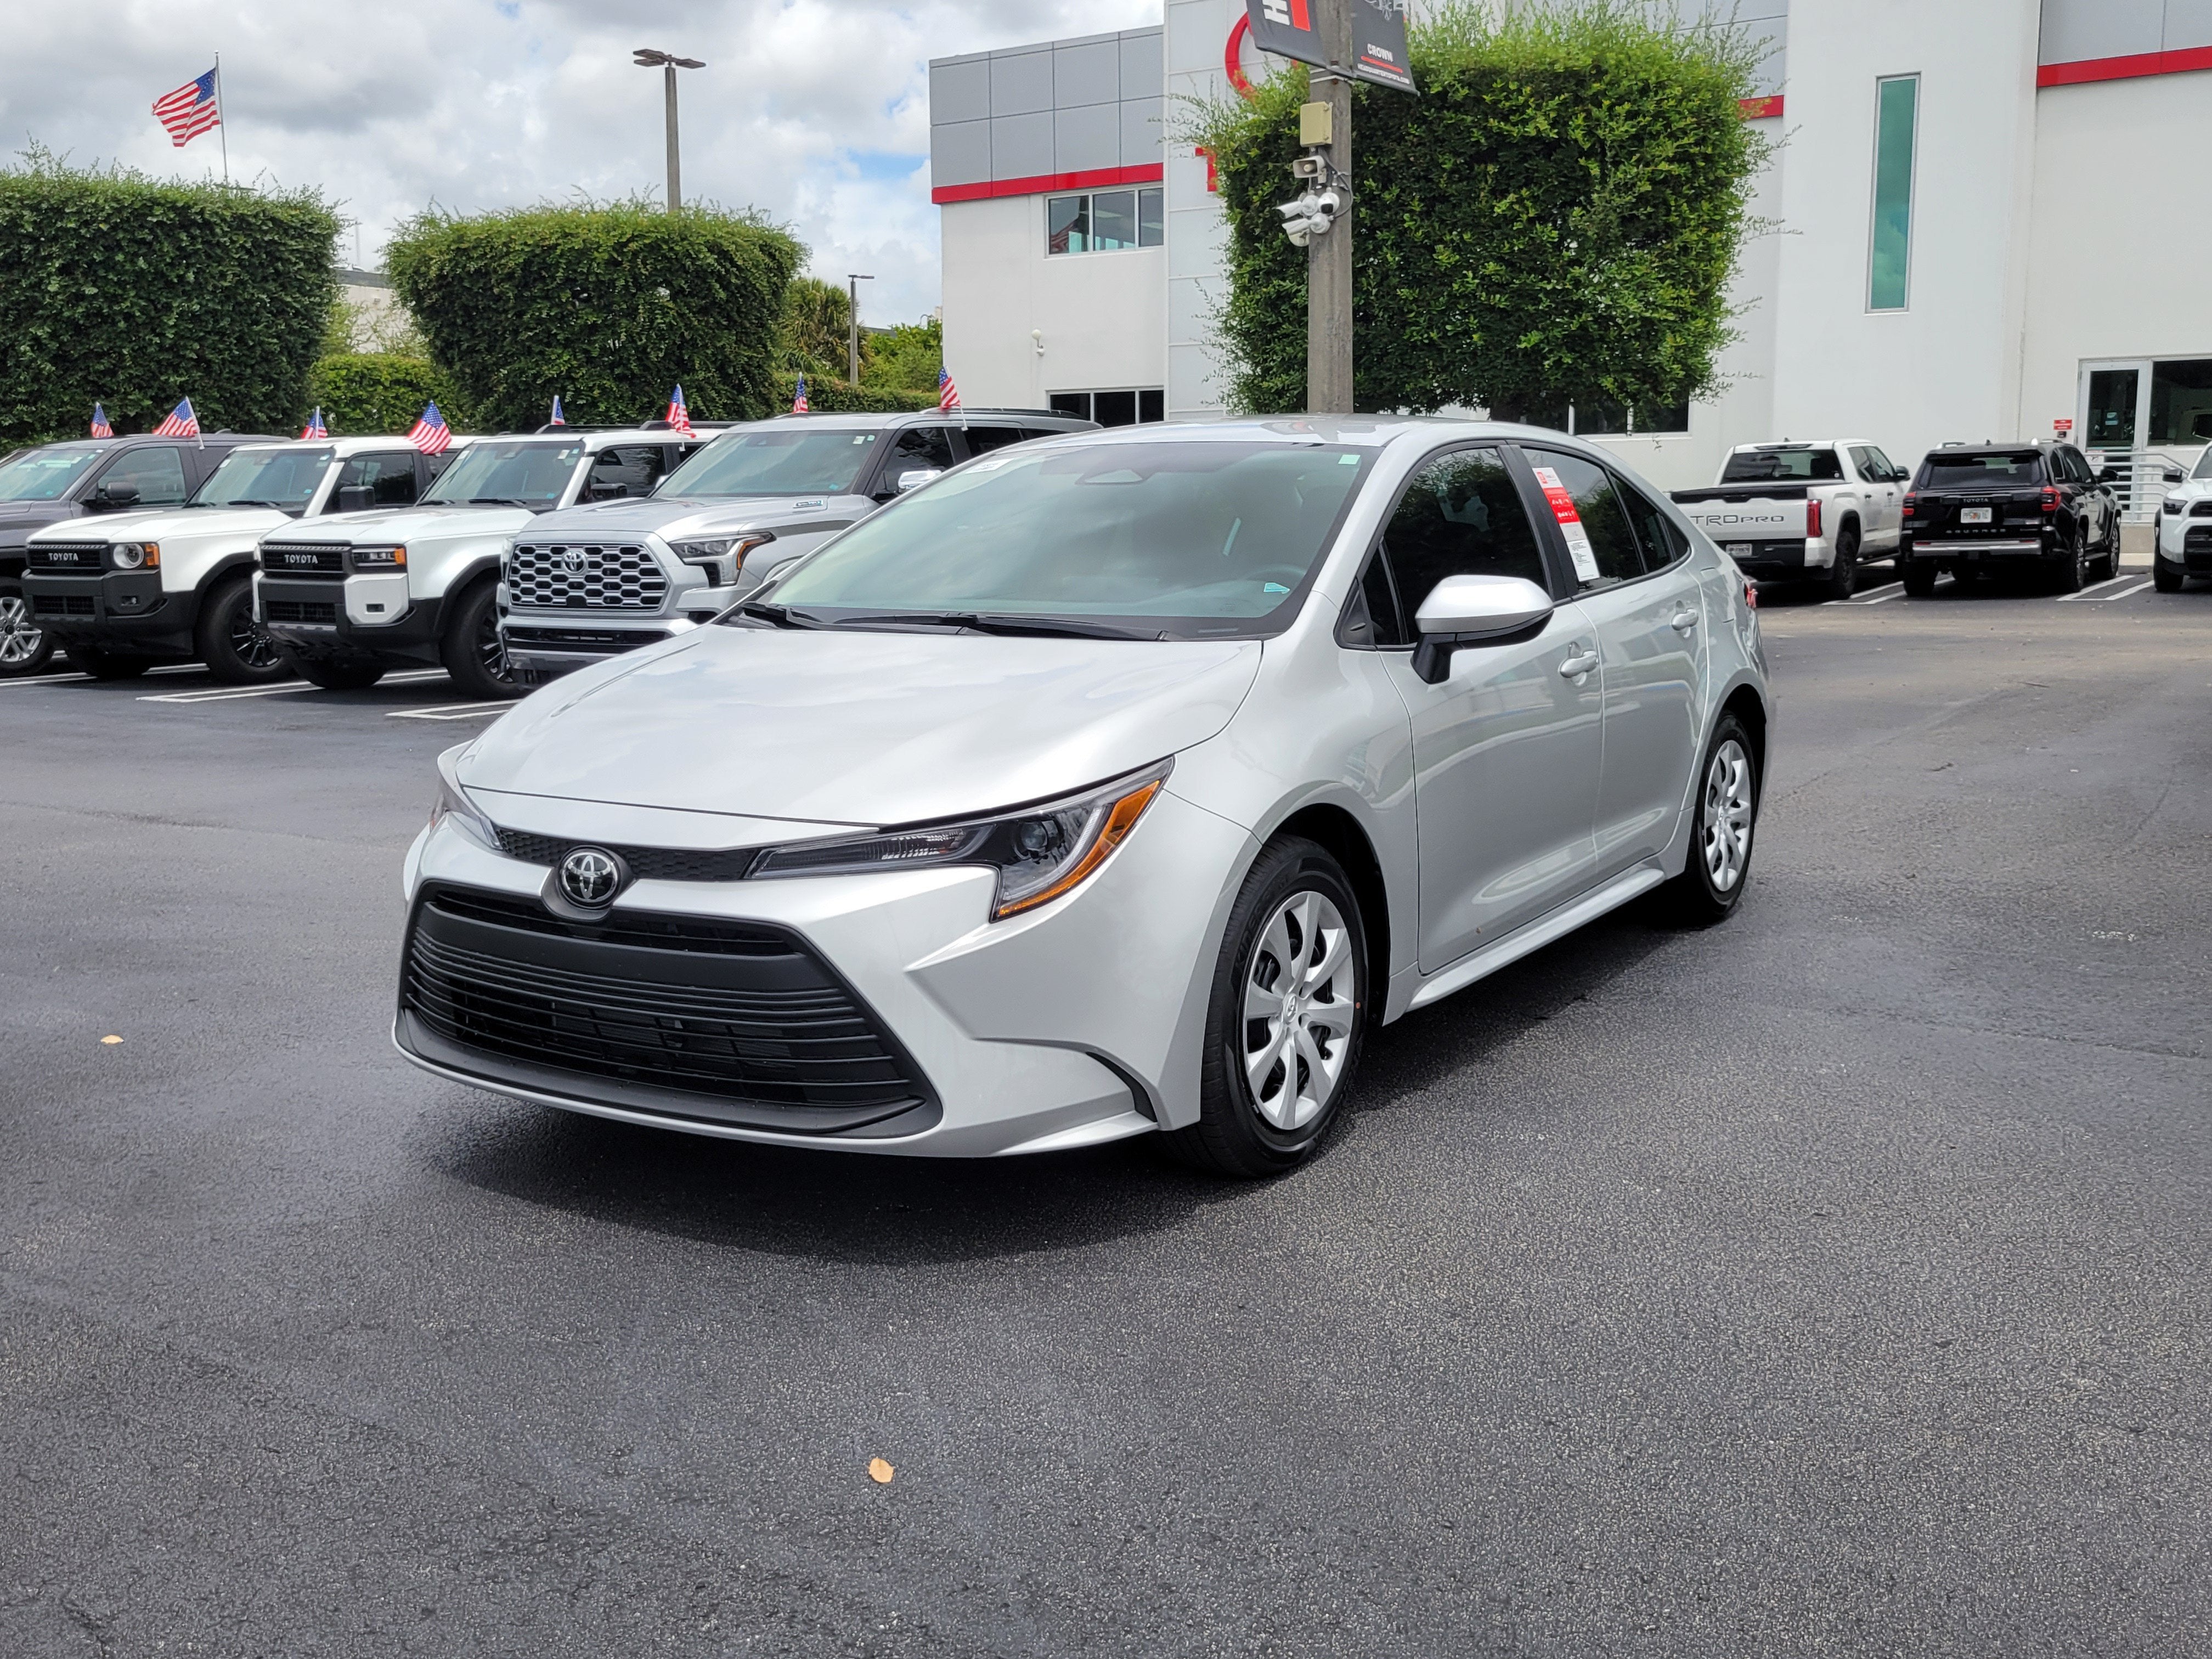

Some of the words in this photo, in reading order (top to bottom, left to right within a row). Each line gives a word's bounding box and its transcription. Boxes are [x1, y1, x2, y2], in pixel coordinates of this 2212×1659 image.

[1367, 43, 1394, 63] CROWN
[1690, 515, 1739, 526] TRD
[48, 552, 78, 561] TOYOTA
[284, 554, 318, 563] TOYOTA
